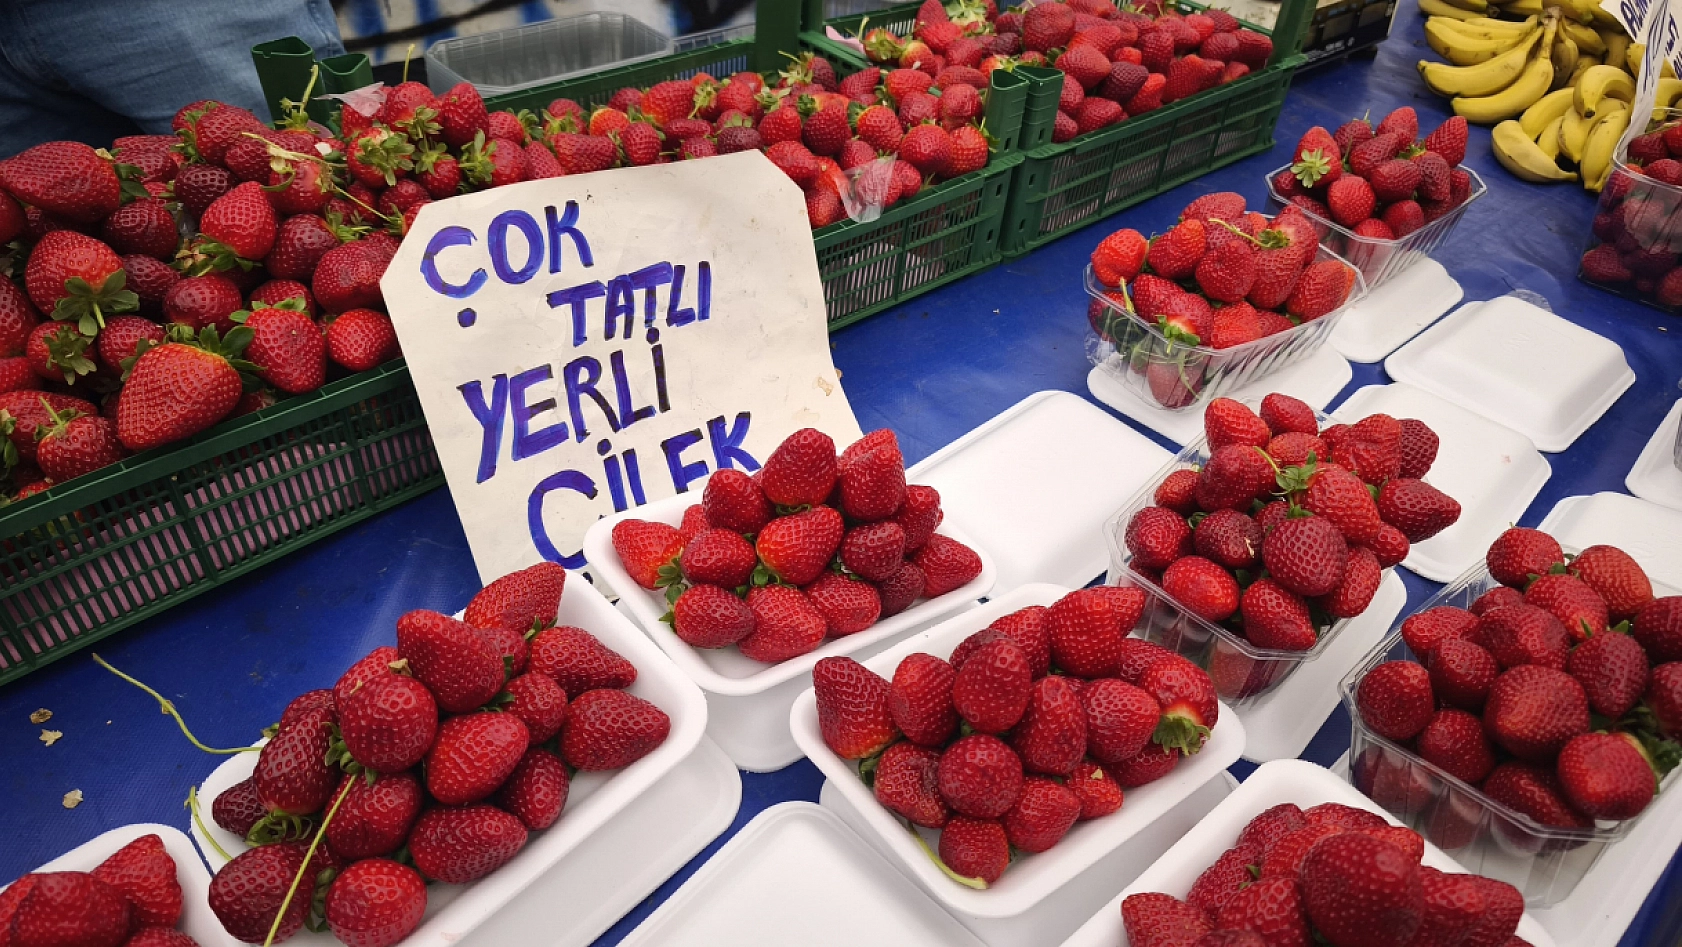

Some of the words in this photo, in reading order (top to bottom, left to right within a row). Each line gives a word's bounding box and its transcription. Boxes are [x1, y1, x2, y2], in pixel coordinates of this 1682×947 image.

[420, 200, 594, 327] ÇOK
[546, 261, 711, 346] TATLI
[456, 327, 670, 483] YERLİ
